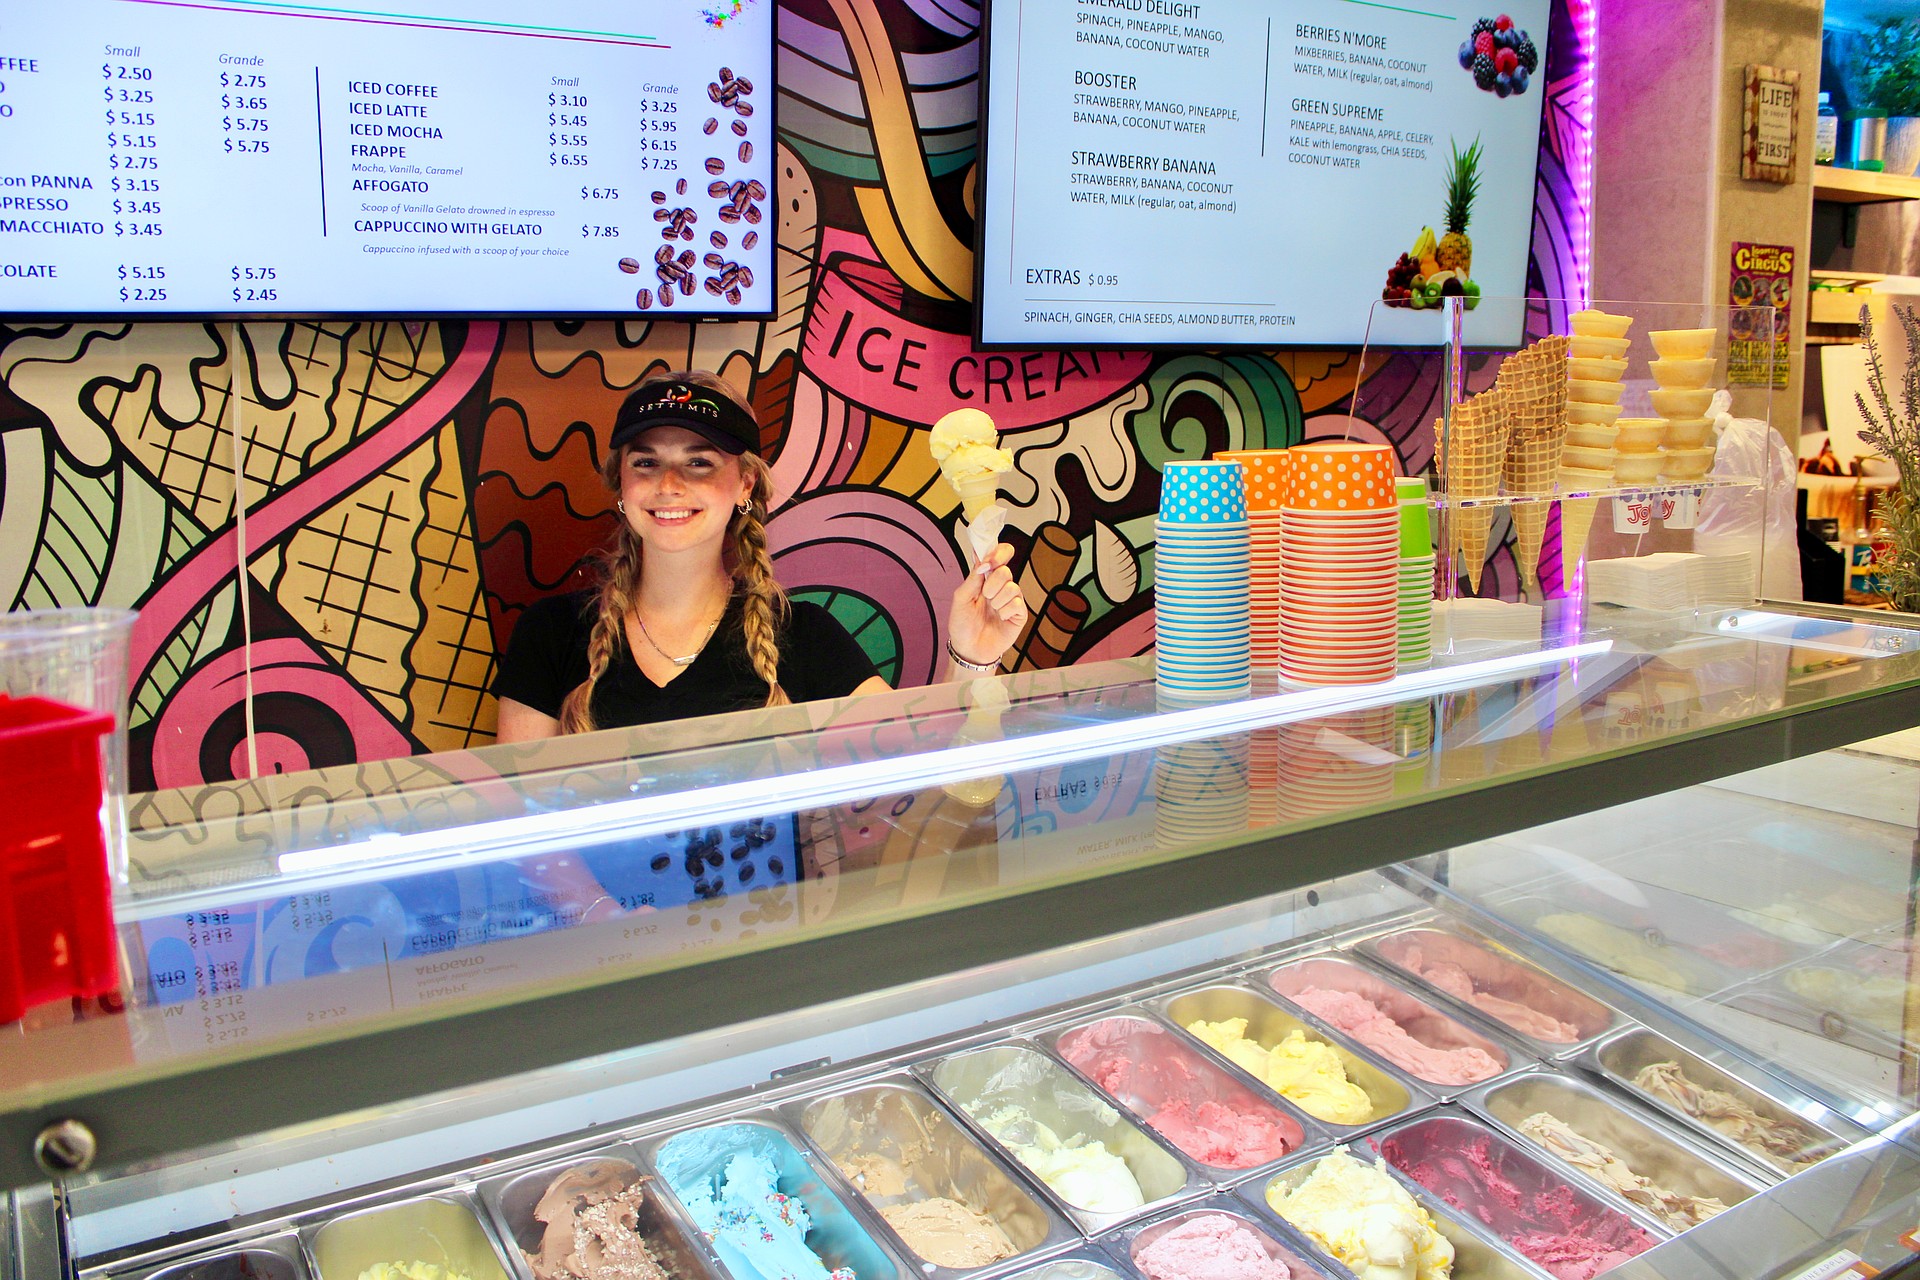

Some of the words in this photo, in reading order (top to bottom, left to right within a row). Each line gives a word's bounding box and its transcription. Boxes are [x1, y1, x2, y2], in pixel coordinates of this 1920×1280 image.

[1146, 0, 1201, 19] DELIGHT
[1077, 12, 1124, 29] SPINACH,
[1127, 19, 1181, 37] PINEAPPLE,
[1184, 27, 1224, 43] MANGO,
[1076, 31, 1124, 48] BANANA,
[1125, 38, 1175, 53] COCONUT
[1177, 44, 1210, 58] WATER
[1296, 24, 1341, 43] BERRIES
[1343, 32, 1387, 50] N'MORE
[105, 45, 141, 57] Small
[218, 54, 264, 66] Grande
[1295, 46, 1347, 63] MIXBERRIES,
[1349, 53, 1386, 68] BANANA,
[1388, 59, 1428, 73] COCONUT
[102, 63, 112, 80] $
[118, 66, 152, 81] 2.50
[220, 72, 229, 88] $
[234, 74, 266, 88] 2.75
[1075, 70, 1137, 90] BOOSTER
[1294, 63, 1325, 77] WATER,
[1328, 67, 1348, 79] MILK
[1350, 70, 1382, 85] (regular,
[1384, 77, 1400, 87] oat,
[1401, 78, 1433, 92] almond)
[348, 81, 382, 94] ICED
[385, 84, 438, 98] COFFEE
[551, 76, 580, 87] Small
[642, 83, 679, 94] Grande
[104, 86, 114, 103] $
[120, 89, 154, 103] 3.25
[221, 93, 230, 110] $
[236, 96, 267, 110] 3.65
[548, 92, 556, 107] $
[560, 94, 588, 107] 3.10
[1761, 87, 1792, 108] LIFE
[349, 102, 382, 115] ICED
[386, 105, 427, 118] LATTE
[640, 98, 648, 113] $
[652, 101, 677, 113] 3.25
[1074, 94, 1142, 111] STRAWBERRY,
[1144, 101, 1186, 116] MANGO,
[1188, 105, 1240, 121] PINEAPPLE,
[1291, 98, 1329, 114] GREEN
[1332, 103, 1384, 121] SUPREME
[105, 109, 115, 126] $
[121, 112, 155, 126] 5.15
[222, 116, 232, 132] $
[237, 118, 268, 132] 5.75
[548, 112, 556, 127] $
[560, 114, 587, 127] 5.45
[640, 118, 648, 132] $
[651, 120, 677, 132] 5.95
[1073, 112, 1120, 126] BANANA,
[1122, 116, 1172, 130] COCONUT
[1173, 121, 1206, 133] WATER
[350, 124, 383, 136] ICED
[387, 126, 443, 139] MOCHA
[549, 132, 557, 146] $
[561, 134, 588, 147] 5.55
[1290, 119, 1337, 134] PINEAPPLE,
[1339, 124, 1376, 138] BANANA,
[1377, 129, 1404, 141] APPLE,
[1405, 132, 1434, 145] CELERY,
[107, 132, 117, 148] $
[122, 134, 156, 148] 5.15
[224, 138, 233, 154] $
[238, 140, 270, 153] 5.75
[640, 137, 648, 151] $
[651, 140, 677, 151] 6.15
[1290, 136, 1310, 147] KALE
[1312, 139, 1331, 149] with
[1332, 141, 1379, 155] lemongrass,
[1381, 145, 1400, 156] CHIA
[1402, 147, 1427, 160] SEEDS,
[351, 144, 406, 158] FRAPPE
[1758, 141, 1791, 159] FIRST
[109, 154, 119, 170] $
[124, 156, 158, 170] 2.75
[549, 152, 557, 166] $
[561, 154, 588, 166] 6.55
[641, 156, 648, 170] $
[652, 158, 678, 170] 7.25
[1072, 151, 1160, 170] STRAWBERRY
[1163, 158, 1216, 175] BANANA
[1288, 153, 1332, 166] COCONUT
[1332, 157, 1361, 168] WATER
[351, 163, 386, 173] Mocha,
[389, 165, 422, 174] Vanilla,
[425, 166, 463, 176] Caramel
[31, 175, 93, 189] PANNA
[111, 176, 120, 192] $
[126, 179, 159, 192] 3.15
[352, 180, 429, 193] AFFOGATO
[1071, 173, 1139, 188] STRAWBERRY,
[1141, 178, 1185, 191] BANANA,
[1187, 181, 1234, 194] COCONUT
[581, 186, 589, 200] $
[592, 188, 619, 200] 6.75
[112, 198, 122, 215] $
[128, 201, 161, 214] 3.45
[360, 203, 389, 214] Scoop
[390, 203, 401, 214] of
[403, 204, 434, 213] Vanilla
[435, 205, 466, 214] Gelato
[468, 206, 507, 215] drowned
[508, 207, 517, 215] in
[1070, 192, 1108, 205] WATER,
[1111, 194, 1135, 205] MILK
[1138, 195, 1176, 209] (regular,
[1178, 200, 1197, 210] oat,
[1198, 200, 1237, 213] almond)
[0, 220, 104, 234] MACCHIATO
[114, 221, 124, 237] $
[130, 223, 162, 236] 3.45
[354, 220, 448, 233] CAPPUCCINO
[451, 222, 488, 234] WITH
[491, 224, 542, 236] GELATO
[582, 224, 589, 238] $
[594, 226, 619, 238] 7.85
[362, 245, 416, 255] Cappuccino
[418, 245, 451, 256] infused
[452, 246, 472, 254] with
[482, 248, 508, 256] scoop
[509, 246, 519, 257] of
[520, 249, 540, 257] your
[542, 248, 570, 256] choice
[1735, 248, 1793, 274] CIRCUS
[117, 264, 127, 281] $
[132, 266, 166, 279] 5.15
[231, 266, 240, 282] $
[245, 268, 276, 280] 5.75
[1026, 268, 1081, 285] EXTRAS
[1088, 273, 1095, 287] $
[1097, 275, 1118, 286] 0.95
[119, 286, 129, 303] $
[134, 288, 167, 301] 2.25
[232, 287, 242, 302] $
[246, 289, 277, 301] 2.45
[1024, 312, 1072, 324] SPINACH,
[1074, 312, 1116, 324] GINGER,
[1118, 313, 1142, 323] CHIA
[1144, 313, 1175, 324] SEEDS,
[1177, 314, 1220, 324] ALMOND
[1221, 314, 1257, 326] BUTTER,
[1260, 315, 1296, 326] PROTEIN
[828, 310, 927, 392] ICE
[949, 351, 1126, 404] CREA
[639, 402, 718, 418] SETTIMI'S
